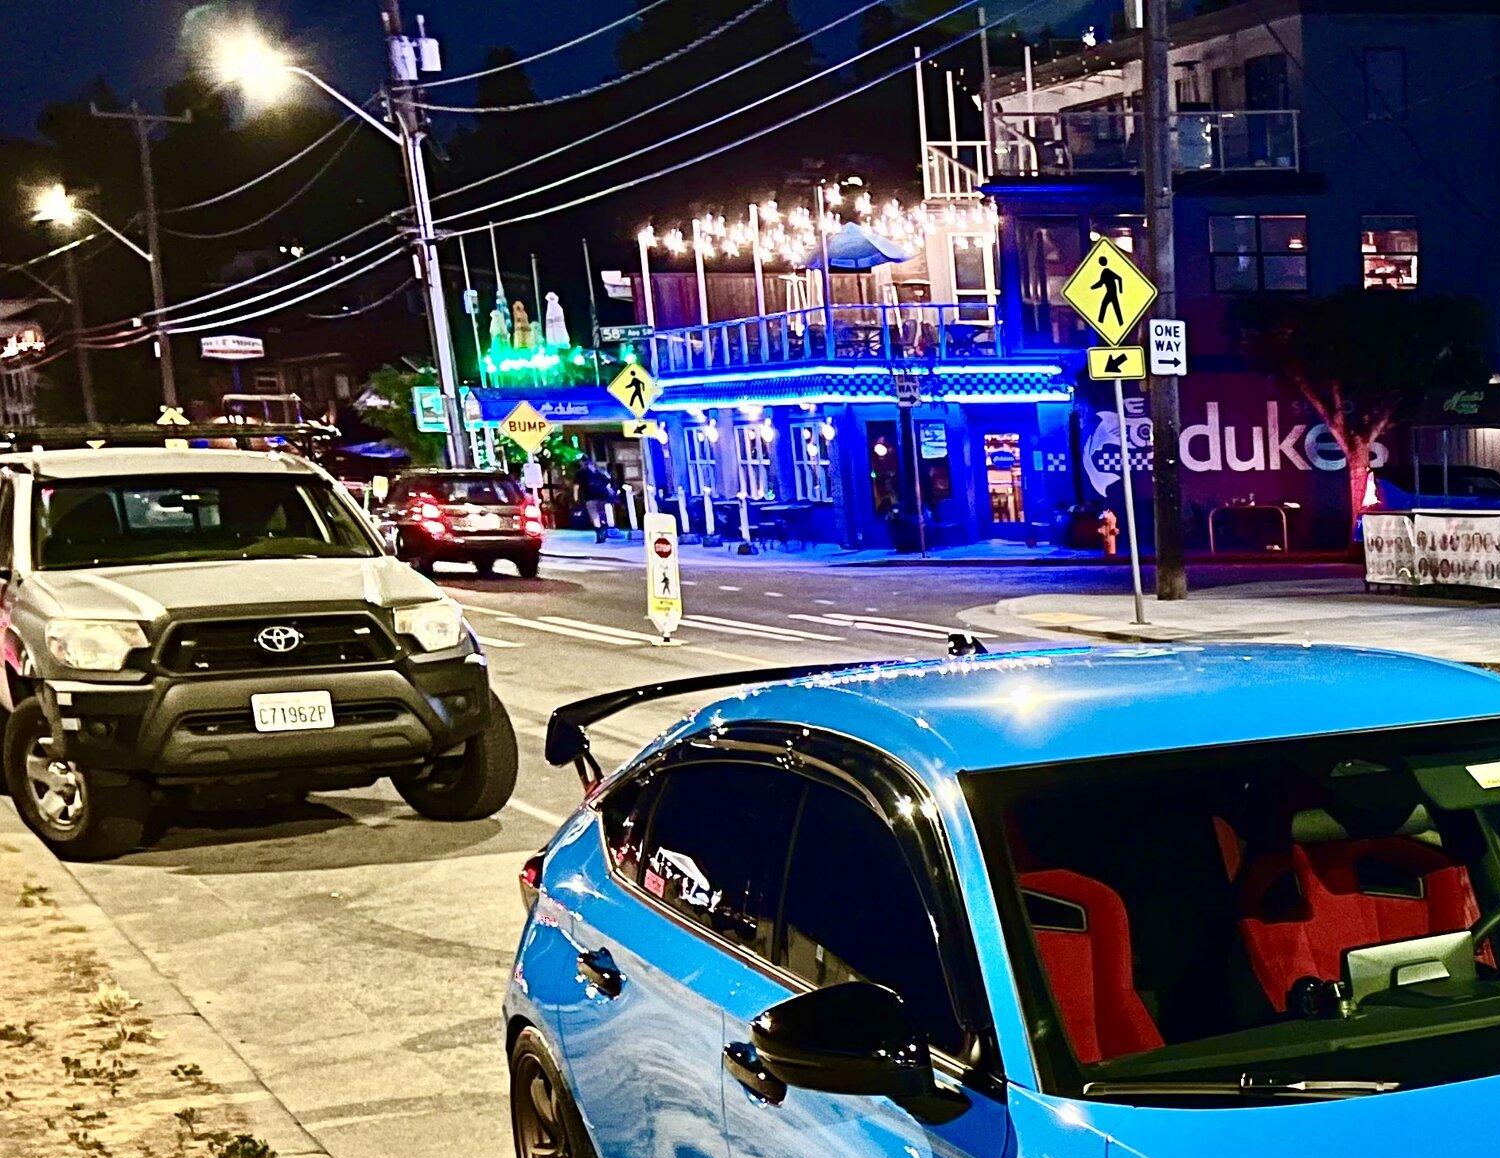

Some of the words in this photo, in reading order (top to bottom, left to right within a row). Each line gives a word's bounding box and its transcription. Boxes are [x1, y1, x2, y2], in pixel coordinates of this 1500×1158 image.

[1154, 324, 1180, 338] ONE
[1154, 339, 1181, 352] WAY
[897, 384, 918, 393] WAY
[555, 402, 590, 415] dukes
[508, 420, 546, 433] BUMP
[655, 543, 671, 553] STOP
[259, 705, 326, 725] C71962P
